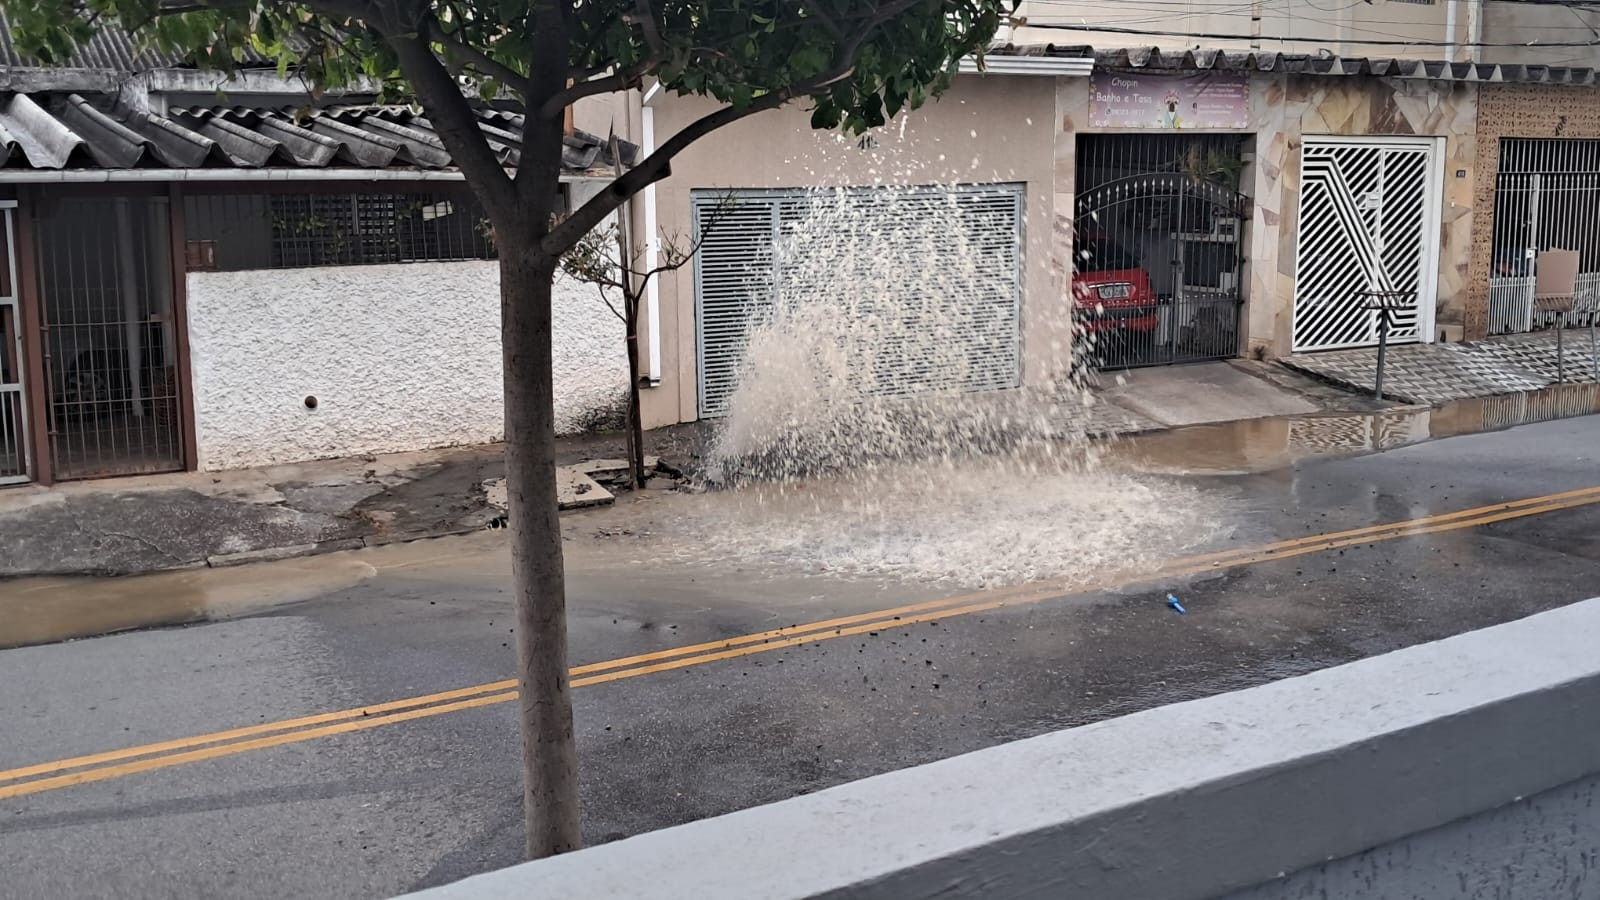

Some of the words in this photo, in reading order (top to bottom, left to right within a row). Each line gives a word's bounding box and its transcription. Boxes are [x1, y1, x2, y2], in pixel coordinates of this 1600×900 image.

[1111, 77, 1138, 90] Chopin
[1096, 91, 1121, 103] Banho
[1124, 95, 1129, 103] e
[1132, 93, 1152, 104] Tosa
